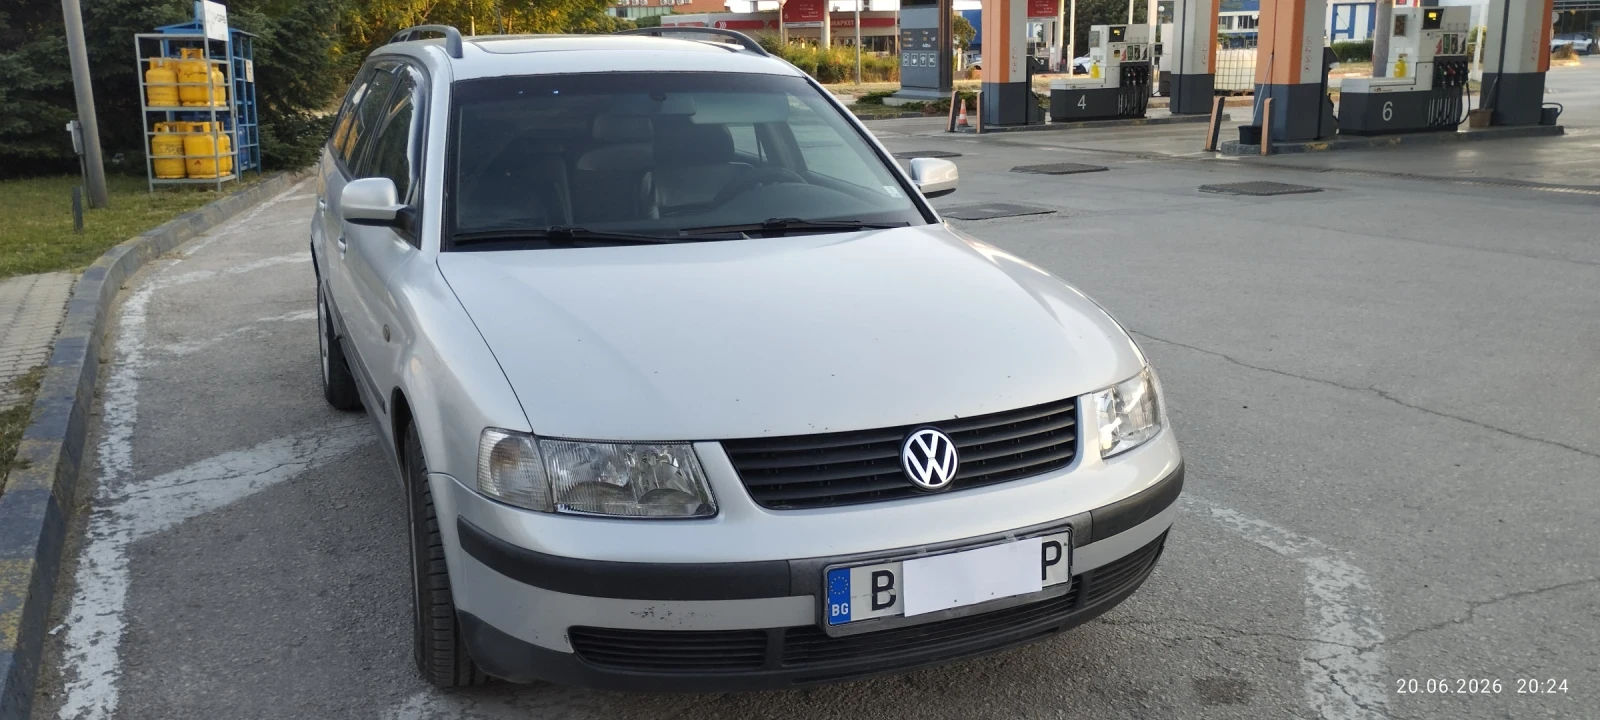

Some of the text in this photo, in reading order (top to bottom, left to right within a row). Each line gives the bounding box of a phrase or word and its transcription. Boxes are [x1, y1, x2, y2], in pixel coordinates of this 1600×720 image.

[1077, 94, 1087, 110] 4
[1382, 101, 1393, 121] 6
[904, 429, 958, 487] VW
[831, 602, 849, 617] BG
